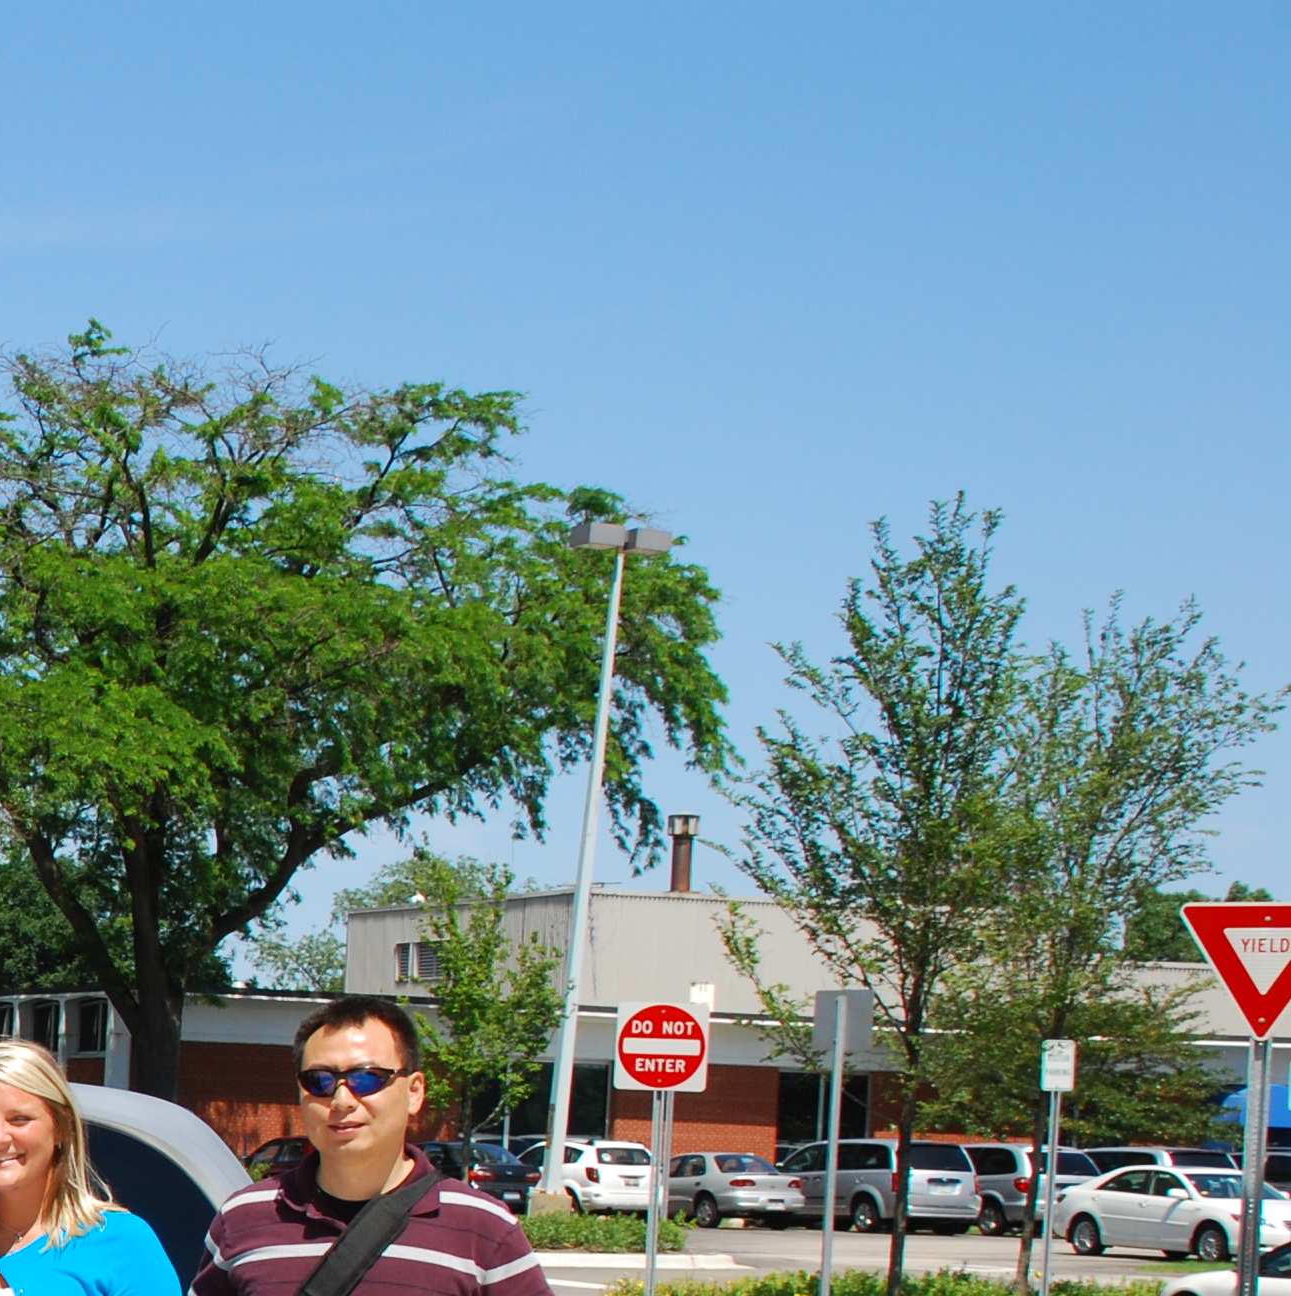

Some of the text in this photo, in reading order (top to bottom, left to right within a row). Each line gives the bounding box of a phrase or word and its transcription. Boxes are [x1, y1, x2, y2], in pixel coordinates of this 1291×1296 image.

[1241, 938, 1290, 953] YIELD
[631, 1020, 695, 1035] DO NOT
[635, 1058, 686, 1073] ENTER
